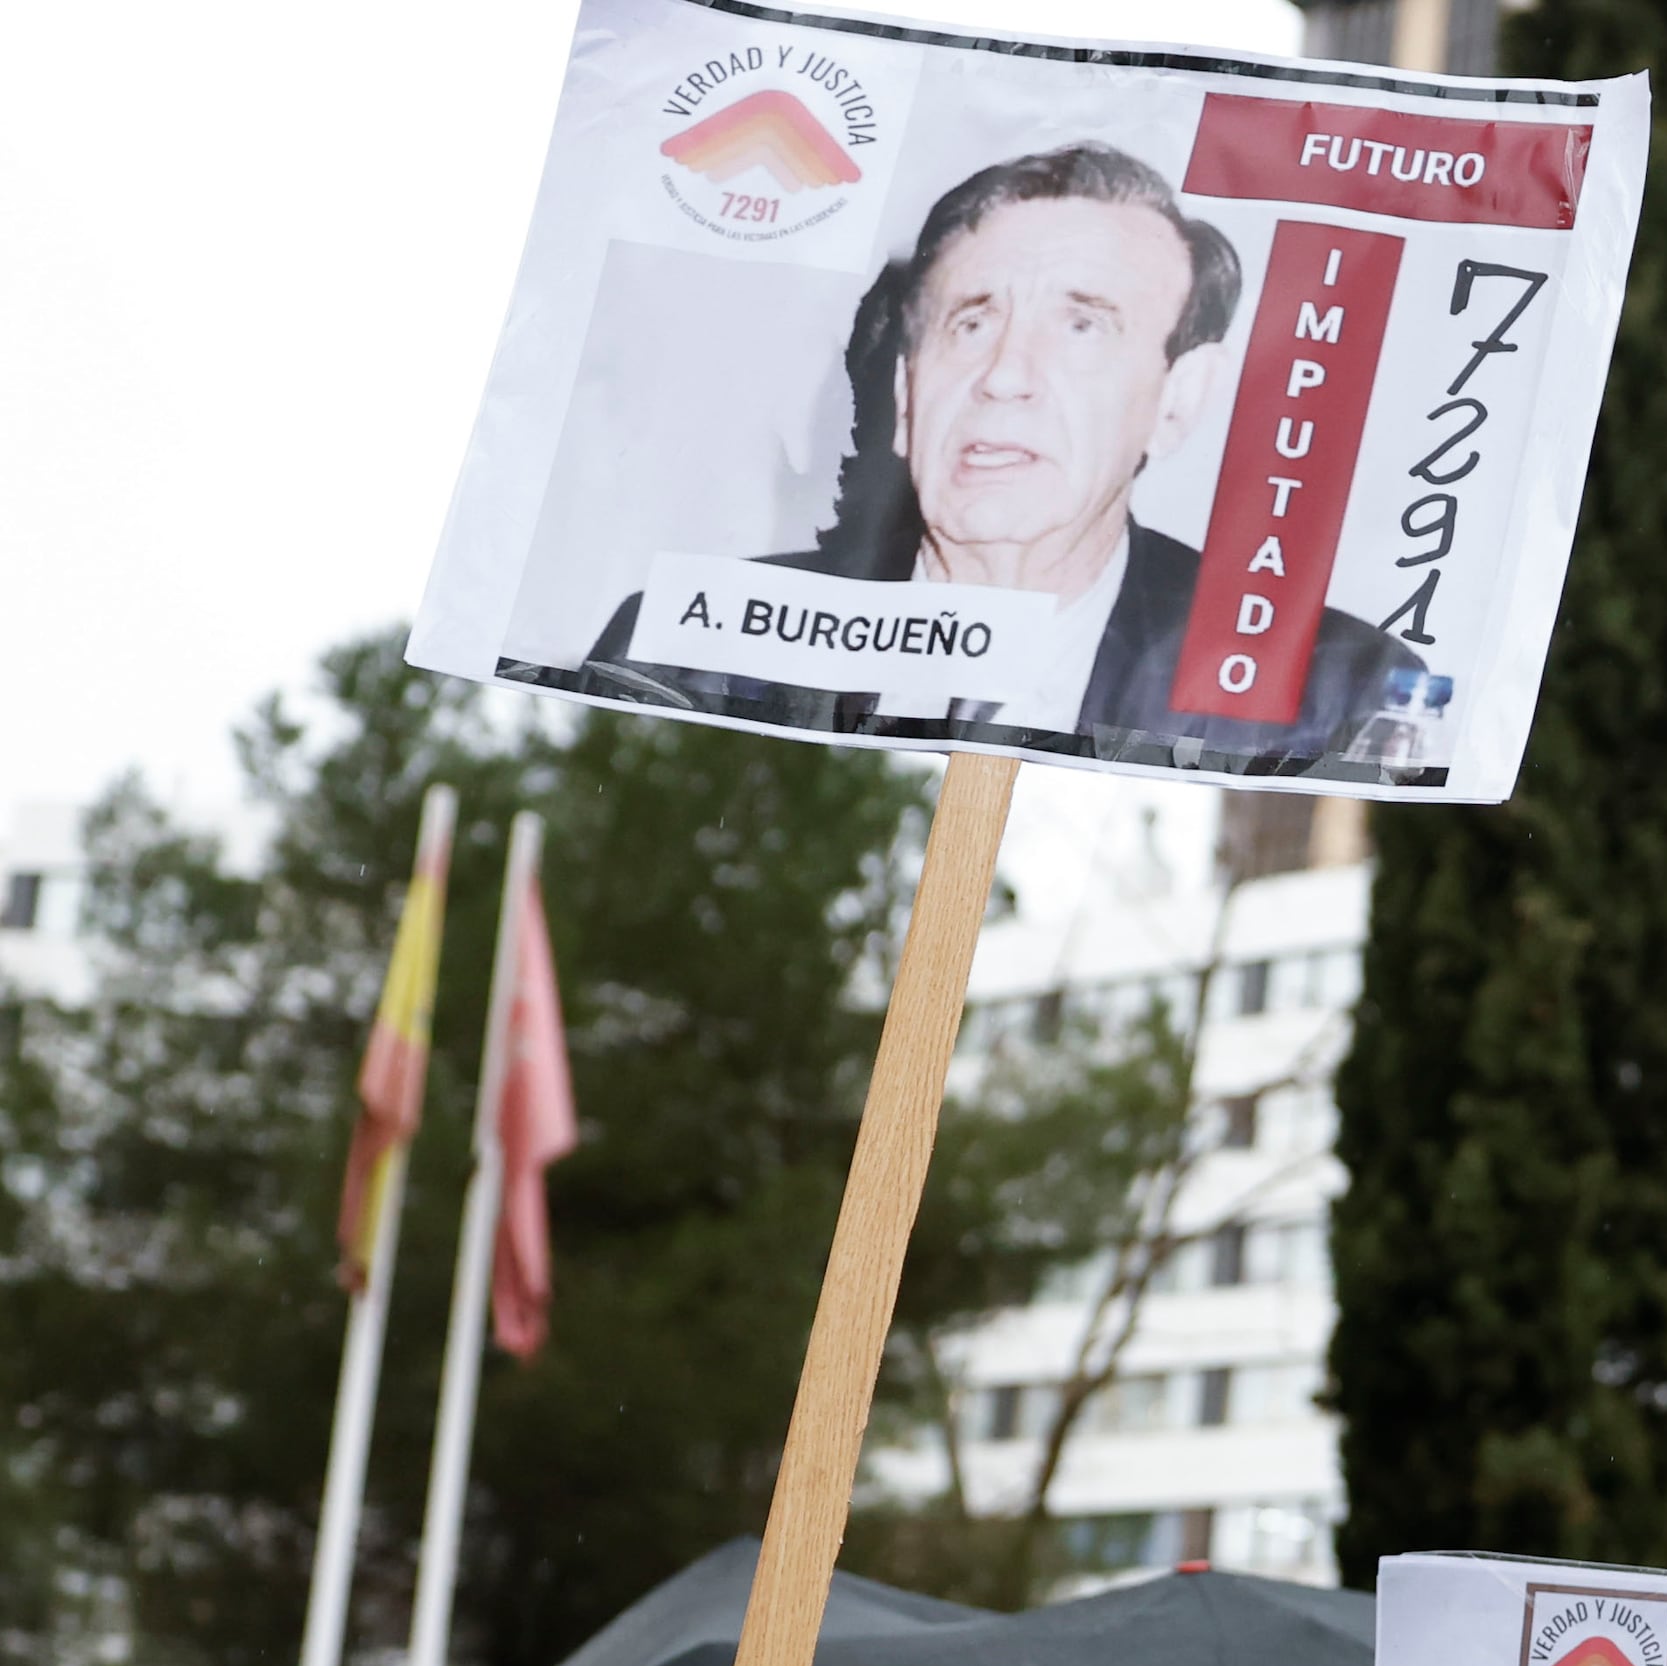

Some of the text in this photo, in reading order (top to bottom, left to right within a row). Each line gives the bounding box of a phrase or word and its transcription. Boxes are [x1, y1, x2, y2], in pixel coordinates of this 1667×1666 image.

[662, 45, 877, 146] VERDAD Y JUSTICIA
[1298, 132, 1487, 189] FUTURO
[719, 192, 781, 223] 7291
[1215, 247, 1343, 696] IMPUTADO
[1378, 258, 1551, 647] 7291
[678, 590, 993, 658] A. BURGUEÑO
[1531, 1601, 1588, 1661] VERDAD
[1595, 1599, 1605, 1620] Y
